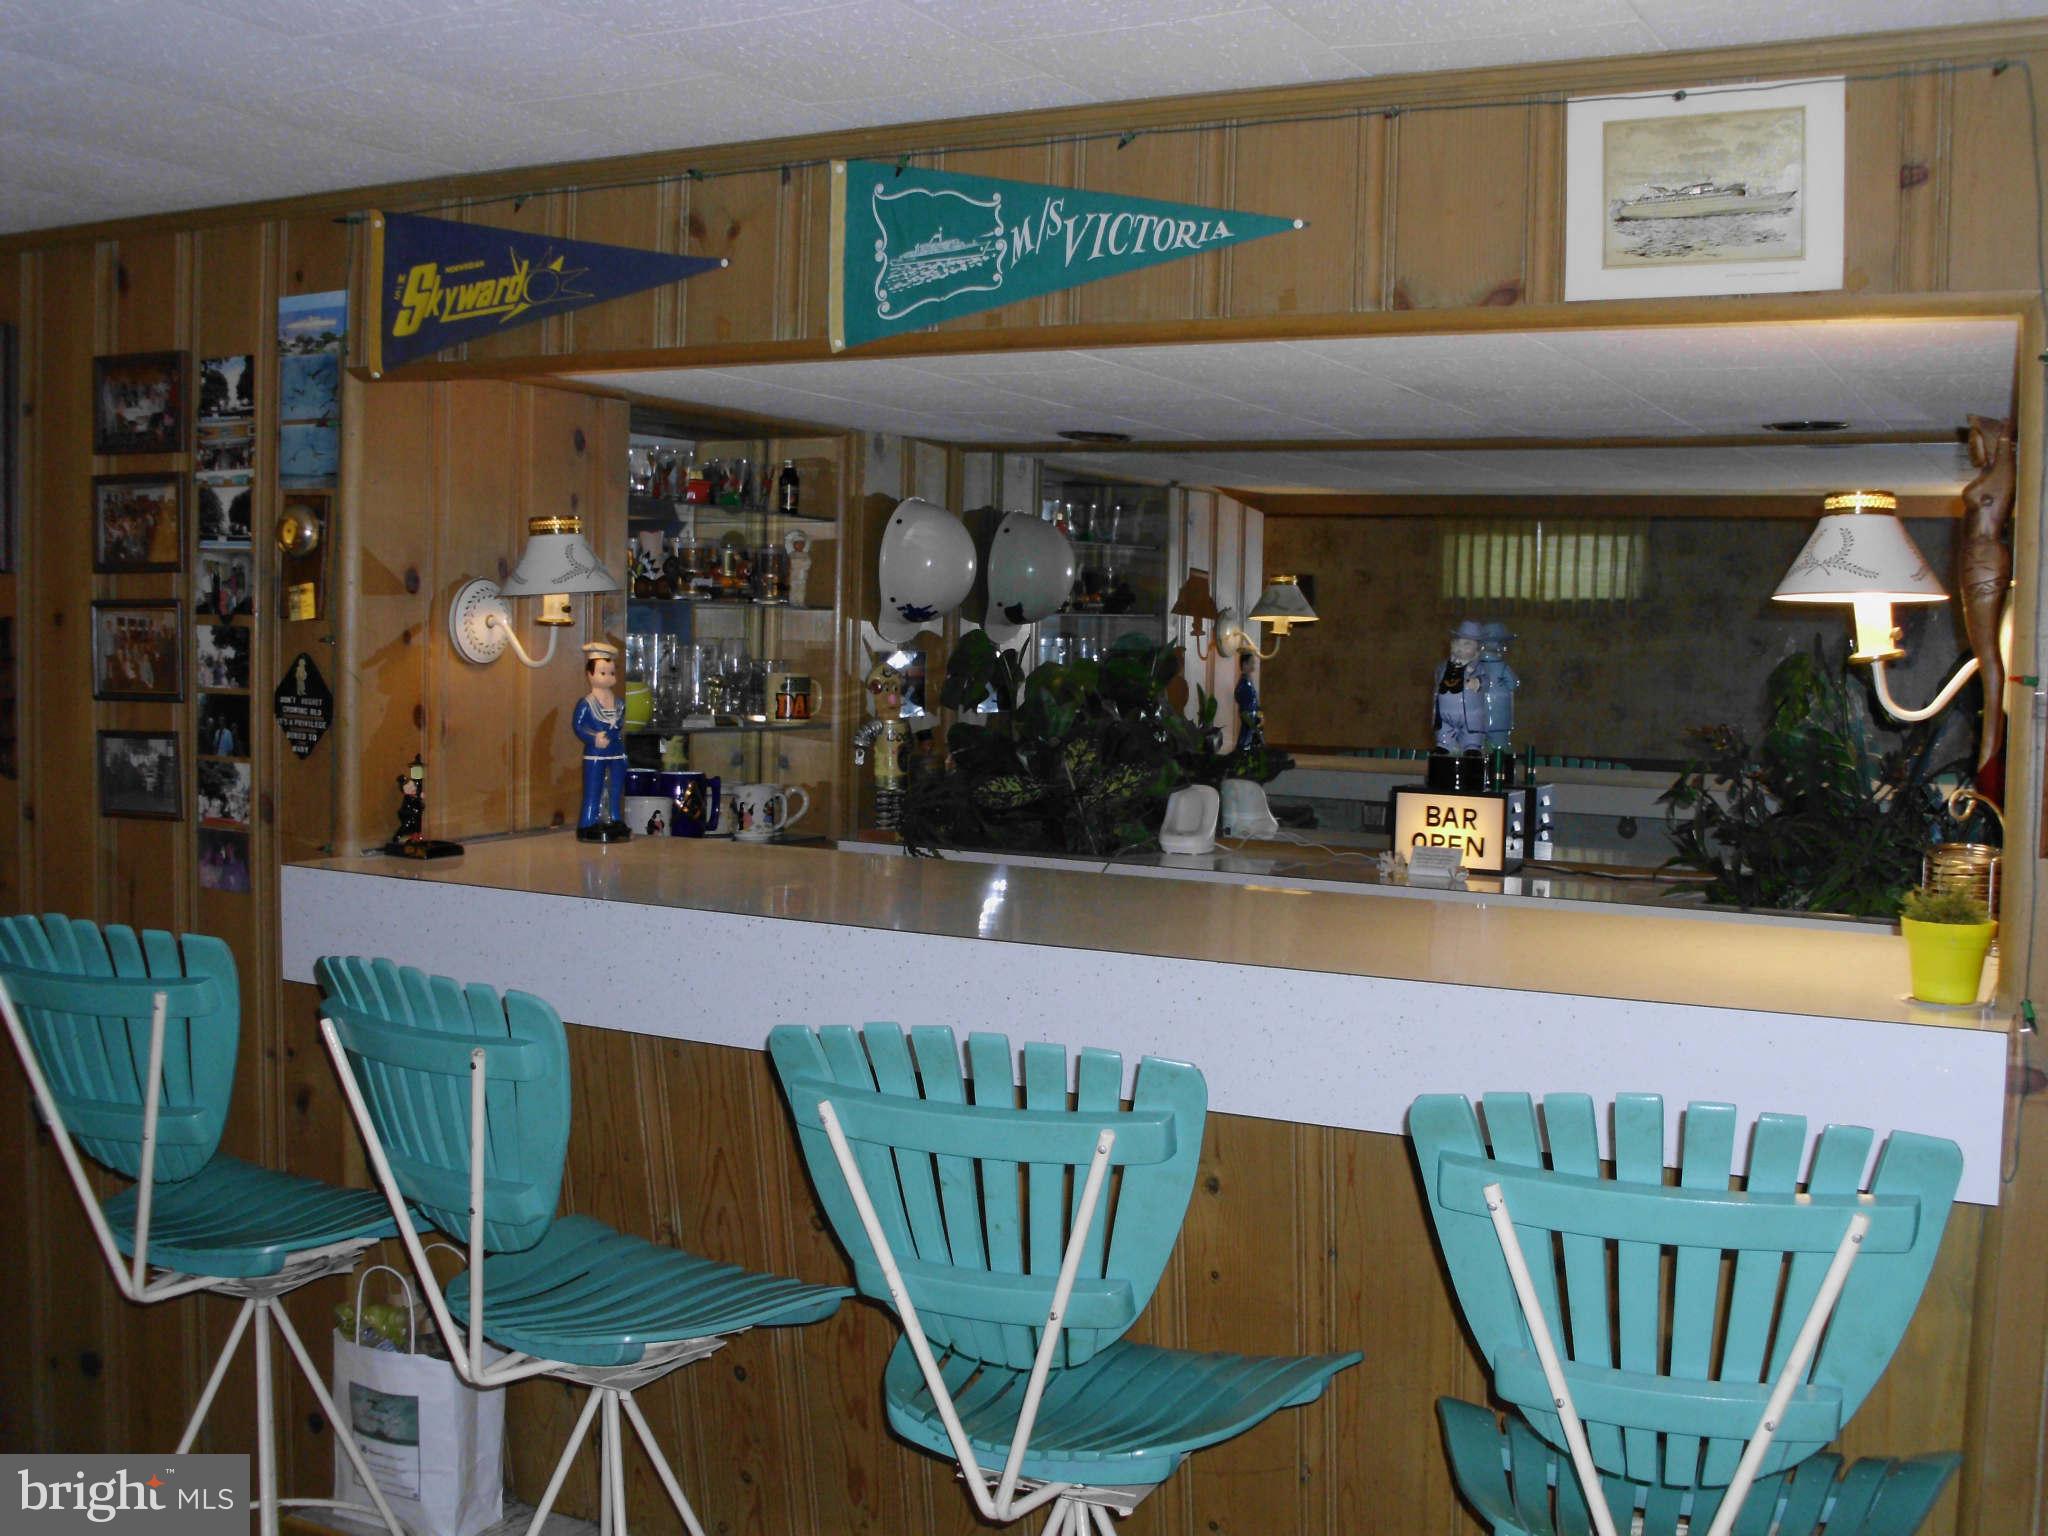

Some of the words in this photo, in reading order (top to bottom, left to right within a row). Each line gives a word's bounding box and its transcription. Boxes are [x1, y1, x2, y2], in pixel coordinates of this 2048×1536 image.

[1010, 196, 1064, 269] M/S
[1063, 211, 1235, 268] VICTORIA
[392, 259, 530, 338] Skyward
[1425, 805, 1478, 830] BAR
